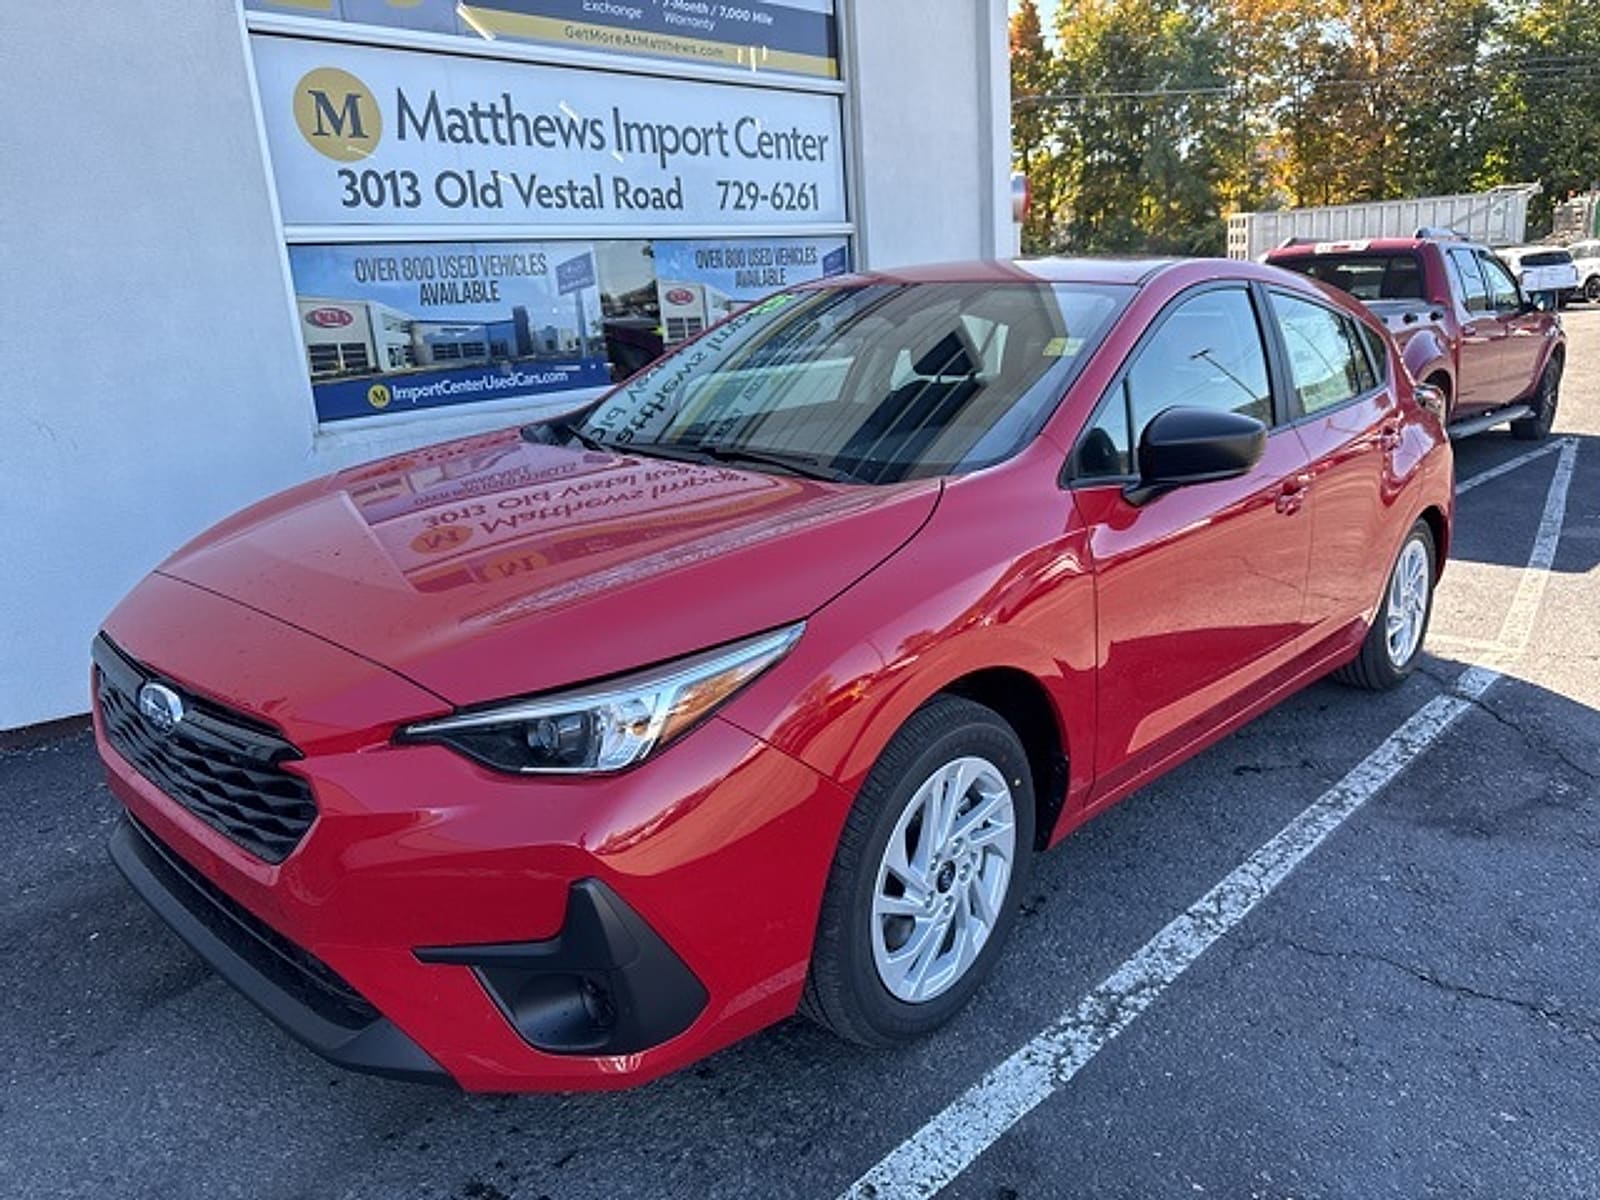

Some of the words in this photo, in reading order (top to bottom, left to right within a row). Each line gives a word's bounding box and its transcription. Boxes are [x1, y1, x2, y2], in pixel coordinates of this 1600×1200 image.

[663, 10, 717, 32] Warranty
[720, 4, 751, 22] 7,000
[564, 25, 725, 57] GetMoreAtMatthews.com
[307, 88, 369, 140] M
[395, 87, 605, 151] Matthews
[612, 106, 730, 169] Import
[734, 117, 829, 163] Center
[337, 168, 422, 210] 3013
[434, 169, 502, 209] Old
[511, 174, 604, 211] Vestal
[614, 176, 684, 211] Road
[716, 180, 820, 212] 729-6261
[355, 257, 398, 283] OVER
[402, 256, 434, 281] 800
[437, 255, 479, 280] USED
[480, 252, 548, 277] VEHICLES
[694, 248, 723, 269] OVER
[748, 247, 772, 267] USED
[774, 246, 818, 266] VEHICLES
[419, 279, 500, 306] AVAILABLE
[735, 267, 787, 289] AVAILABLE
[392, 371, 569, 404] ImportCenterUsedCars.com
